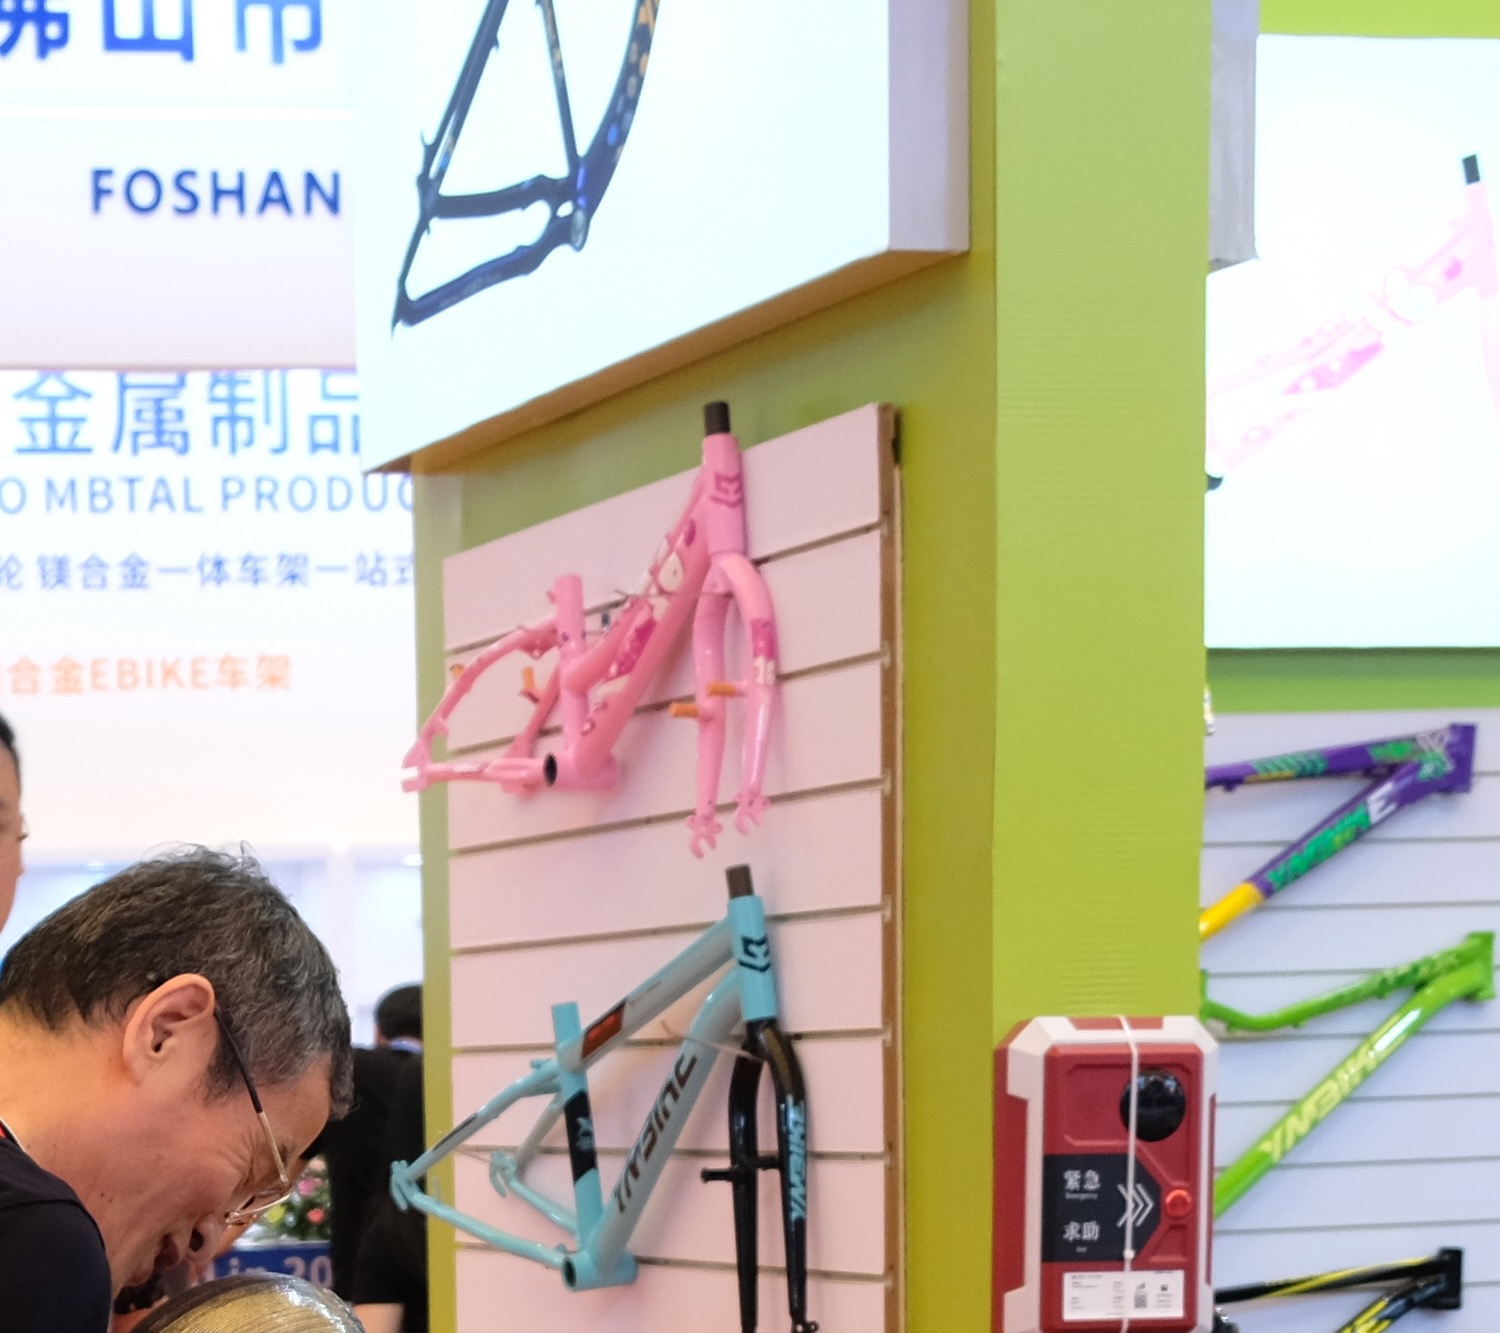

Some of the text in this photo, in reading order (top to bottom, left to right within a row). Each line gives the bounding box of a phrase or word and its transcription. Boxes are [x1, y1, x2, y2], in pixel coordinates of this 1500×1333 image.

[91, 167, 340, 217] FOSHAN
[44, 475, 205, 515] MBTAL
[1063, 1169, 1101, 1191] 紧急
[1062, 1220, 1100, 1242] 求助
